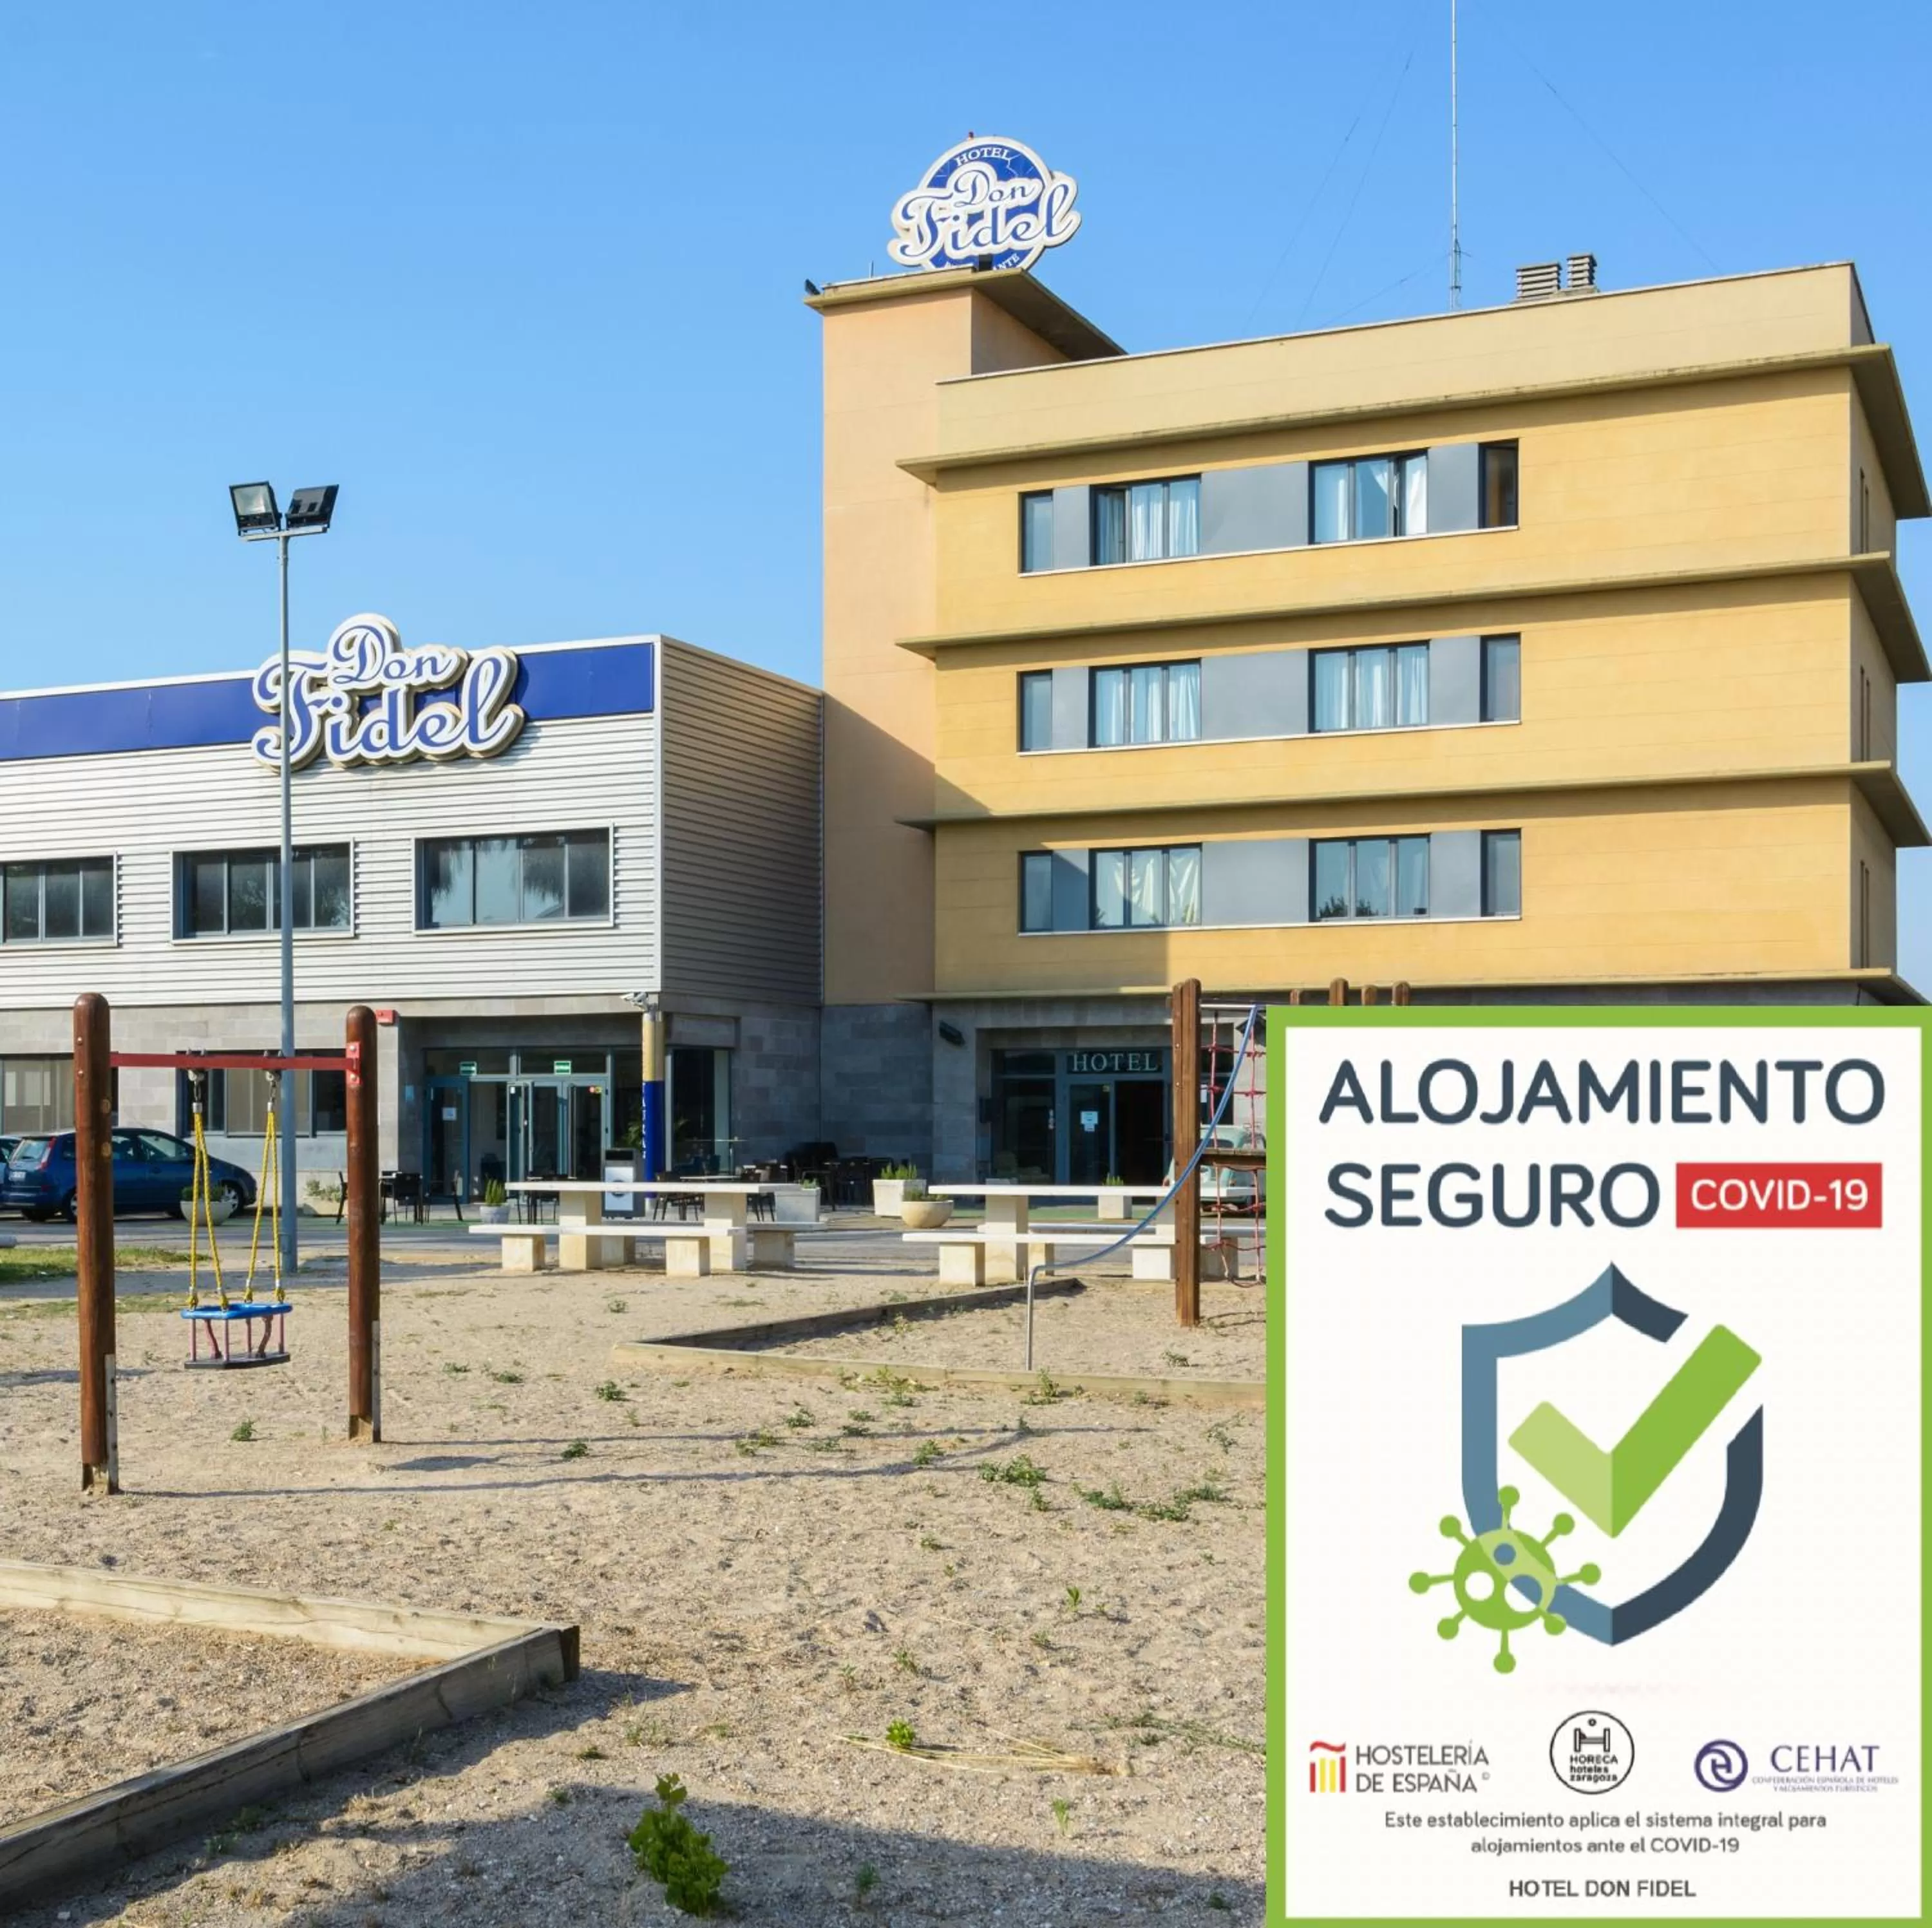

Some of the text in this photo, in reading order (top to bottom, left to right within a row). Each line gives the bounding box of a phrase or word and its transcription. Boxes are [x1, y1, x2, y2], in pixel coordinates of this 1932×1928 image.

[954, 147, 1010, 167] HOTEL
[954, 169, 1036, 207] Don
[900, 183, 1075, 257] Fidel
[332, 625, 451, 684] Don
[256, 656, 509, 760] Fidel
[1072, 1052, 1159, 1072] HOTEL
